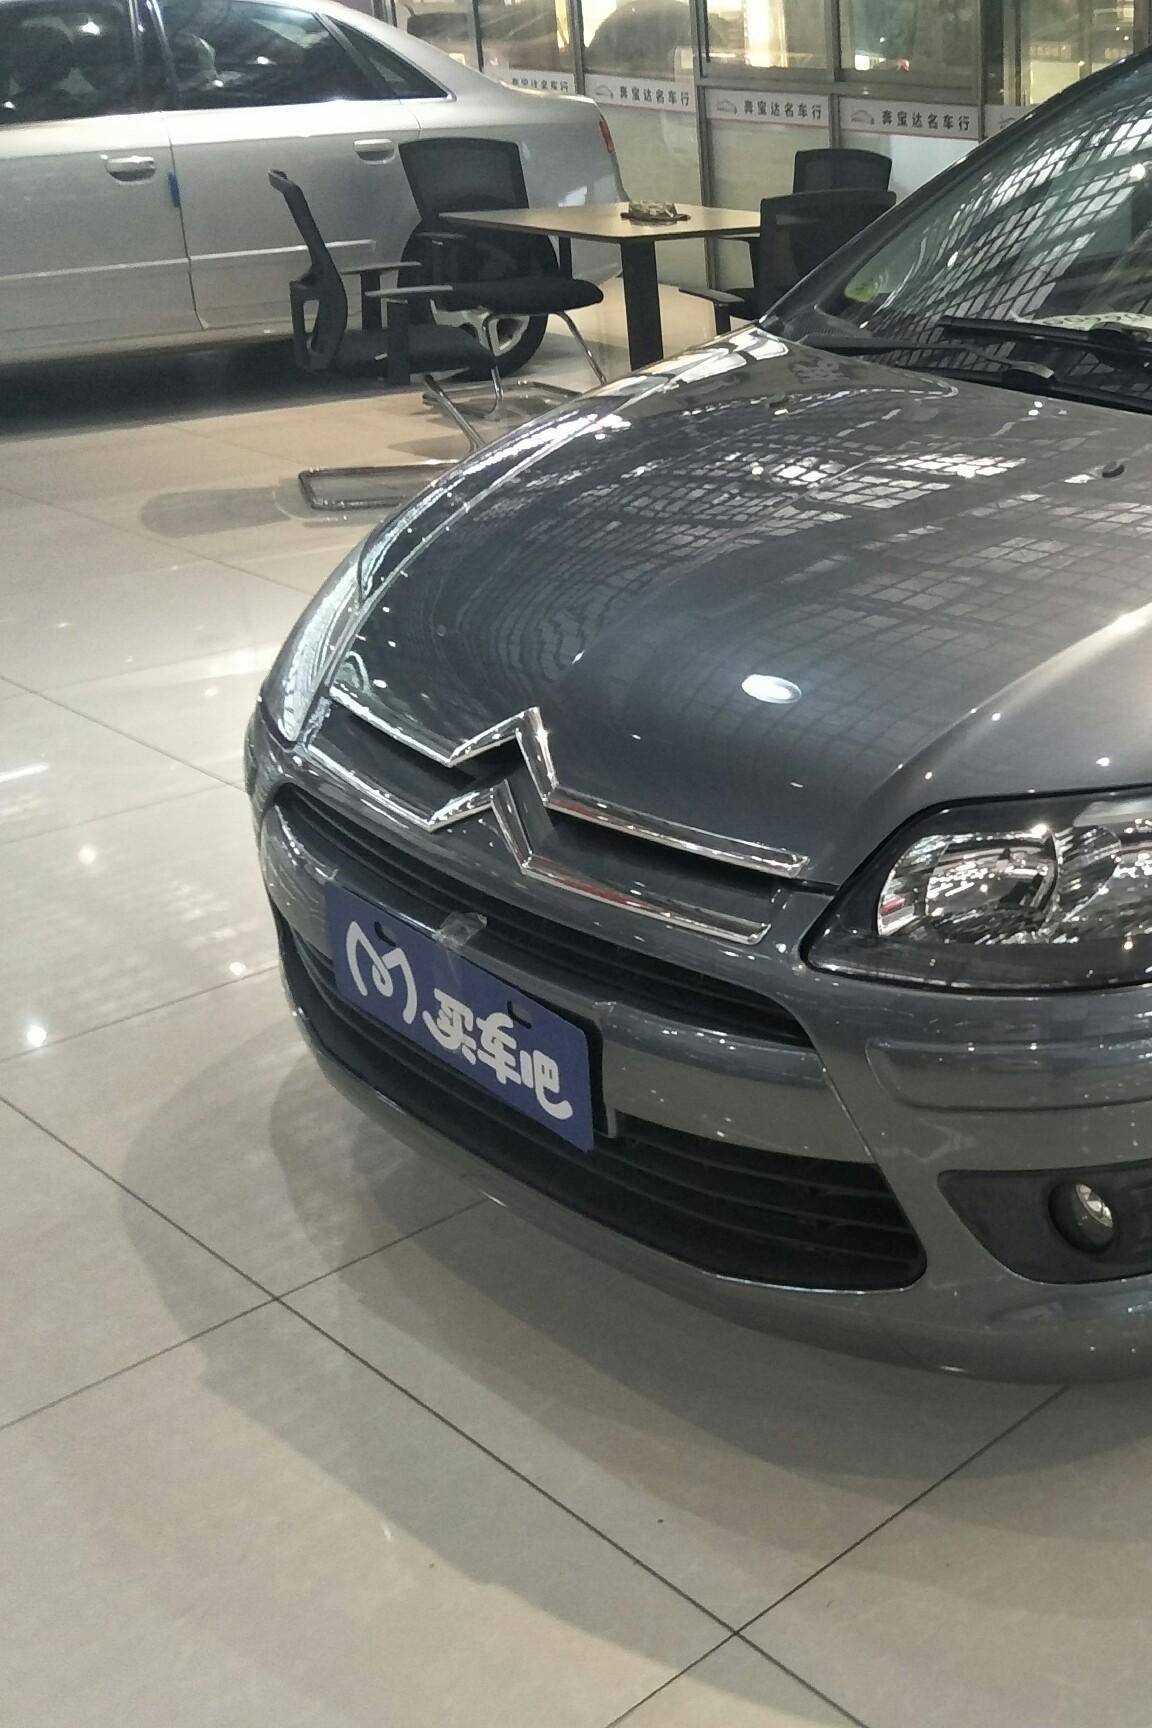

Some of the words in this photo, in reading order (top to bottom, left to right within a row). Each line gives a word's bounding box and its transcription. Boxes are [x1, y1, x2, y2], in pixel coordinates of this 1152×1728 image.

[619, 85, 689, 106] 奔宝达名车行
[744, 99, 822, 120] 奔宝达名车行
[882, 109, 970, 131] 奔宝达名车行
[421, 987, 574, 1120] 买车吧
